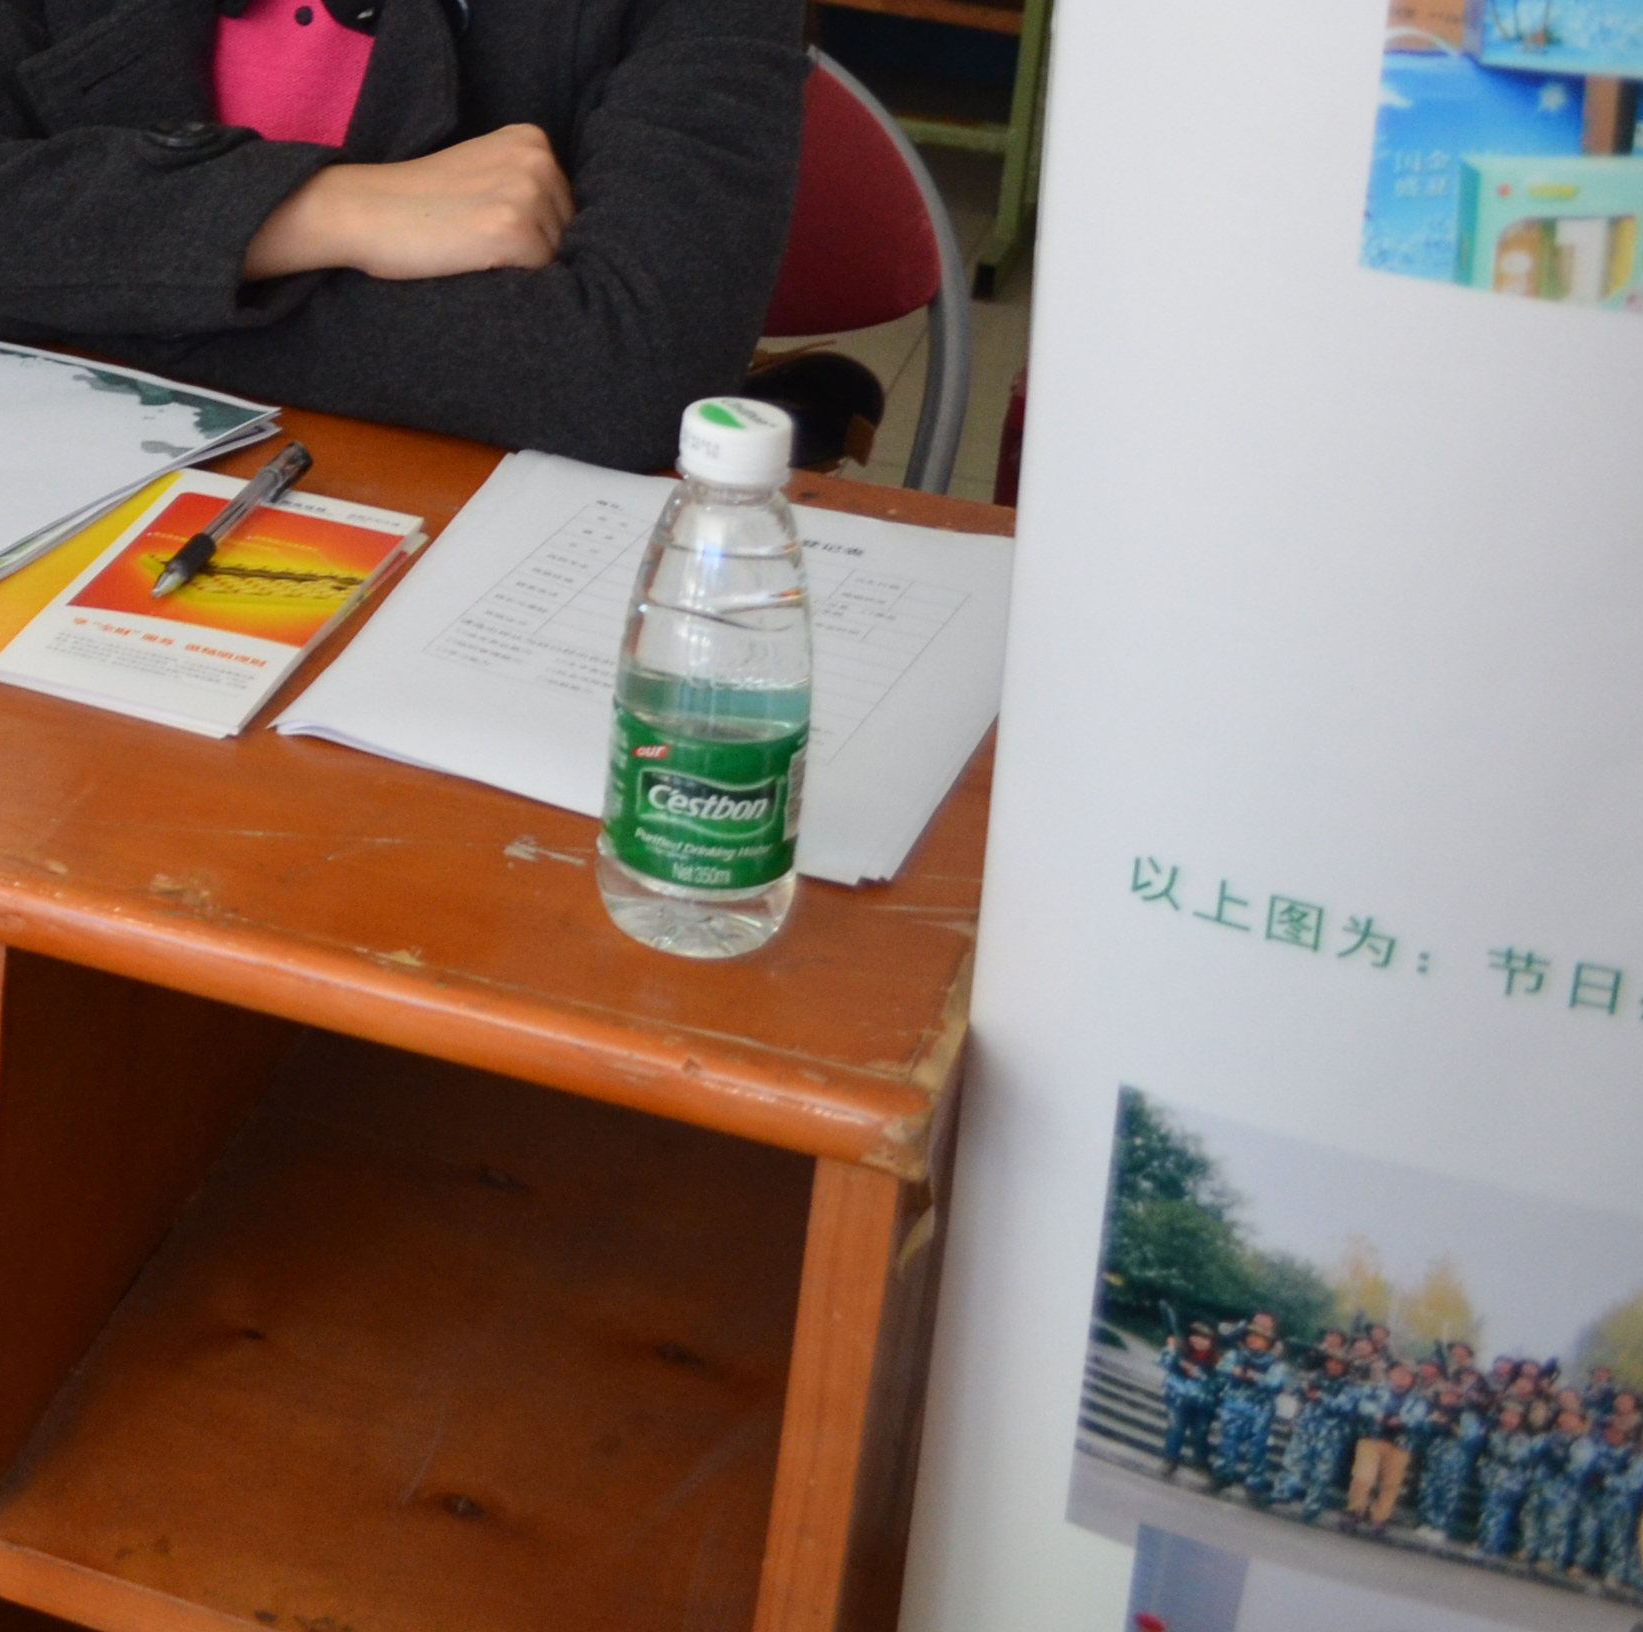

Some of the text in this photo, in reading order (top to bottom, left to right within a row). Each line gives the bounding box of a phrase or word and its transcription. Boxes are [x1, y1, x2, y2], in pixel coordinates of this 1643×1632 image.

[1131, 856, 1643, 1022] 以上图为：节日
